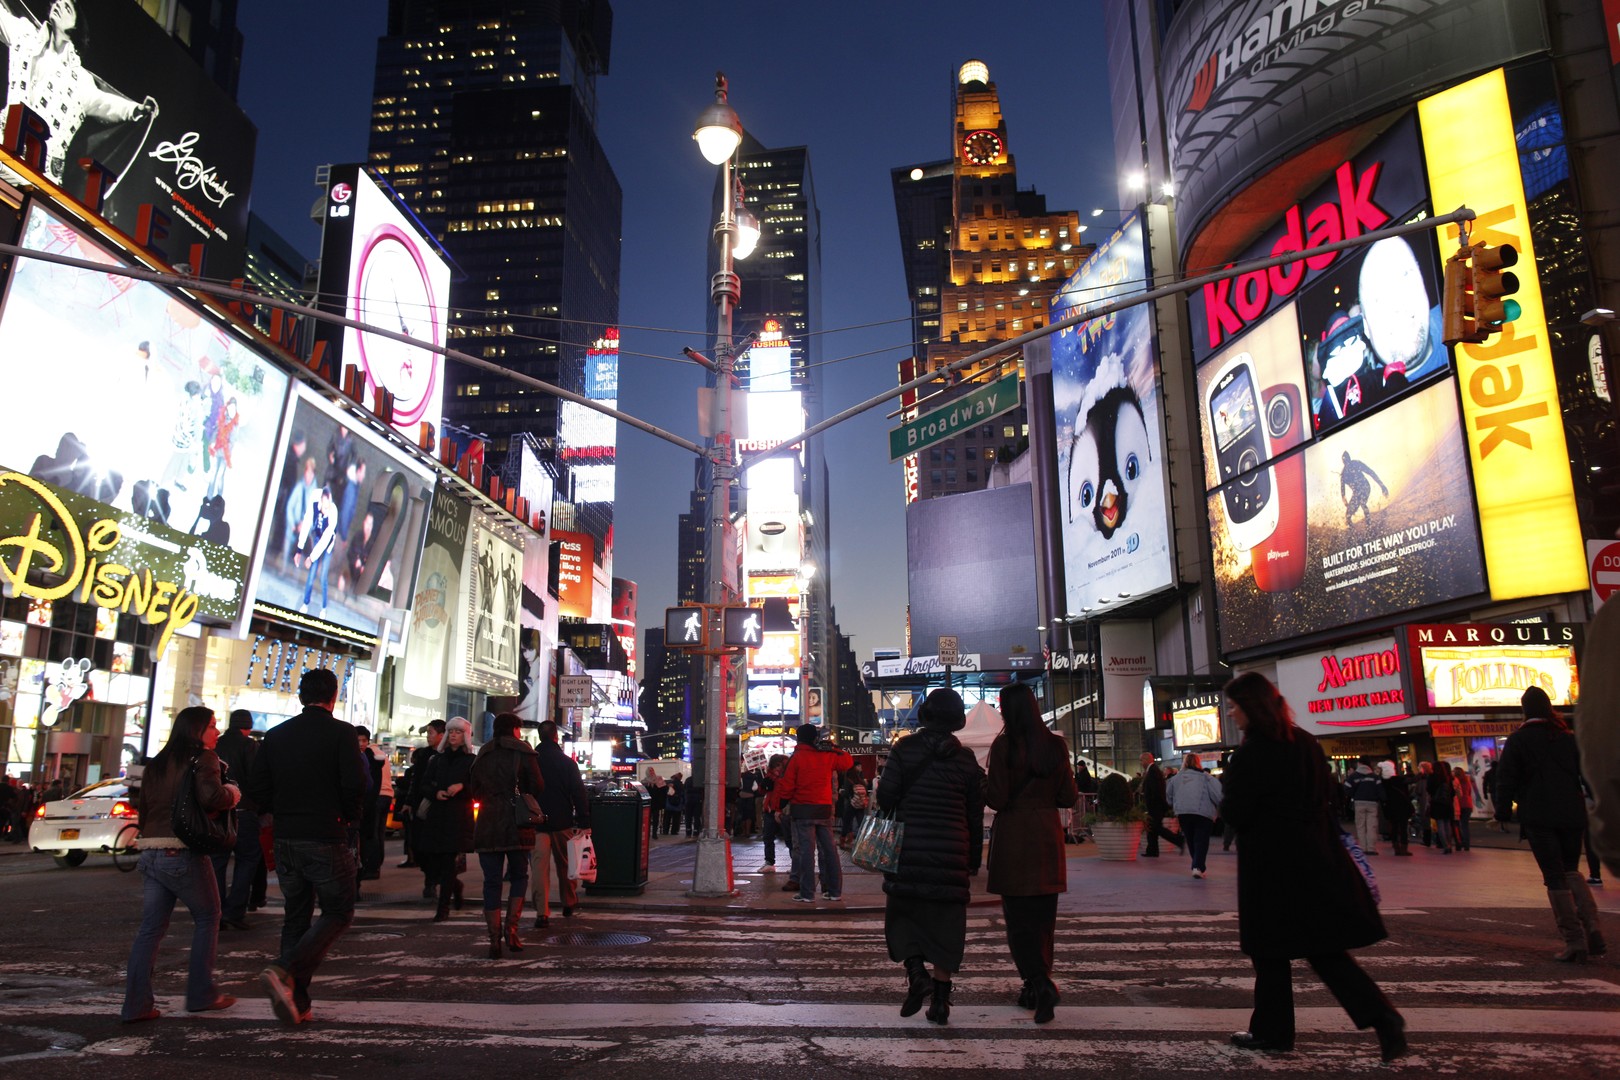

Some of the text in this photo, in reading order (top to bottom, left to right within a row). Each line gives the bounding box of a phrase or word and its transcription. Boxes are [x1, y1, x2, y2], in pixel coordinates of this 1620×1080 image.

[1251, 14, 1336, 77] driving
[330, 204, 350, 218] LG
[1203, 160, 1391, 349] Kodak
[1446, 203, 1550, 462] Kdak
[752, 340, 790, 348] TOSHIBA
[907, 391, 999, 447] Broadway
[740, 438, 801, 451] TOSHIA
[436, 491, 459, 518] NYC's
[1322, 514, 1457, 569] BUILT FOR THE WAY YOU PLAY.
[1110, 547, 1122, 560] 2011
[1324, 538, 1437, 580] WATERPROOF. SHOCKPROOF. DUSTPROOF.
[562, 561, 575, 571] like
[1418, 626, 1574, 643] MARQUIS
[1108, 655, 1147, 667] Marriott
[1317, 642, 1401, 693] Marriot
[1450, 661, 1558, 705] FOLLIES
[1172, 694, 1219, 710] MARQUIS
[1308, 698, 1334, 713] NEW
[1335, 693, 1369, 710] YORK
[1480, 723, 1509, 734] VIBRANT
